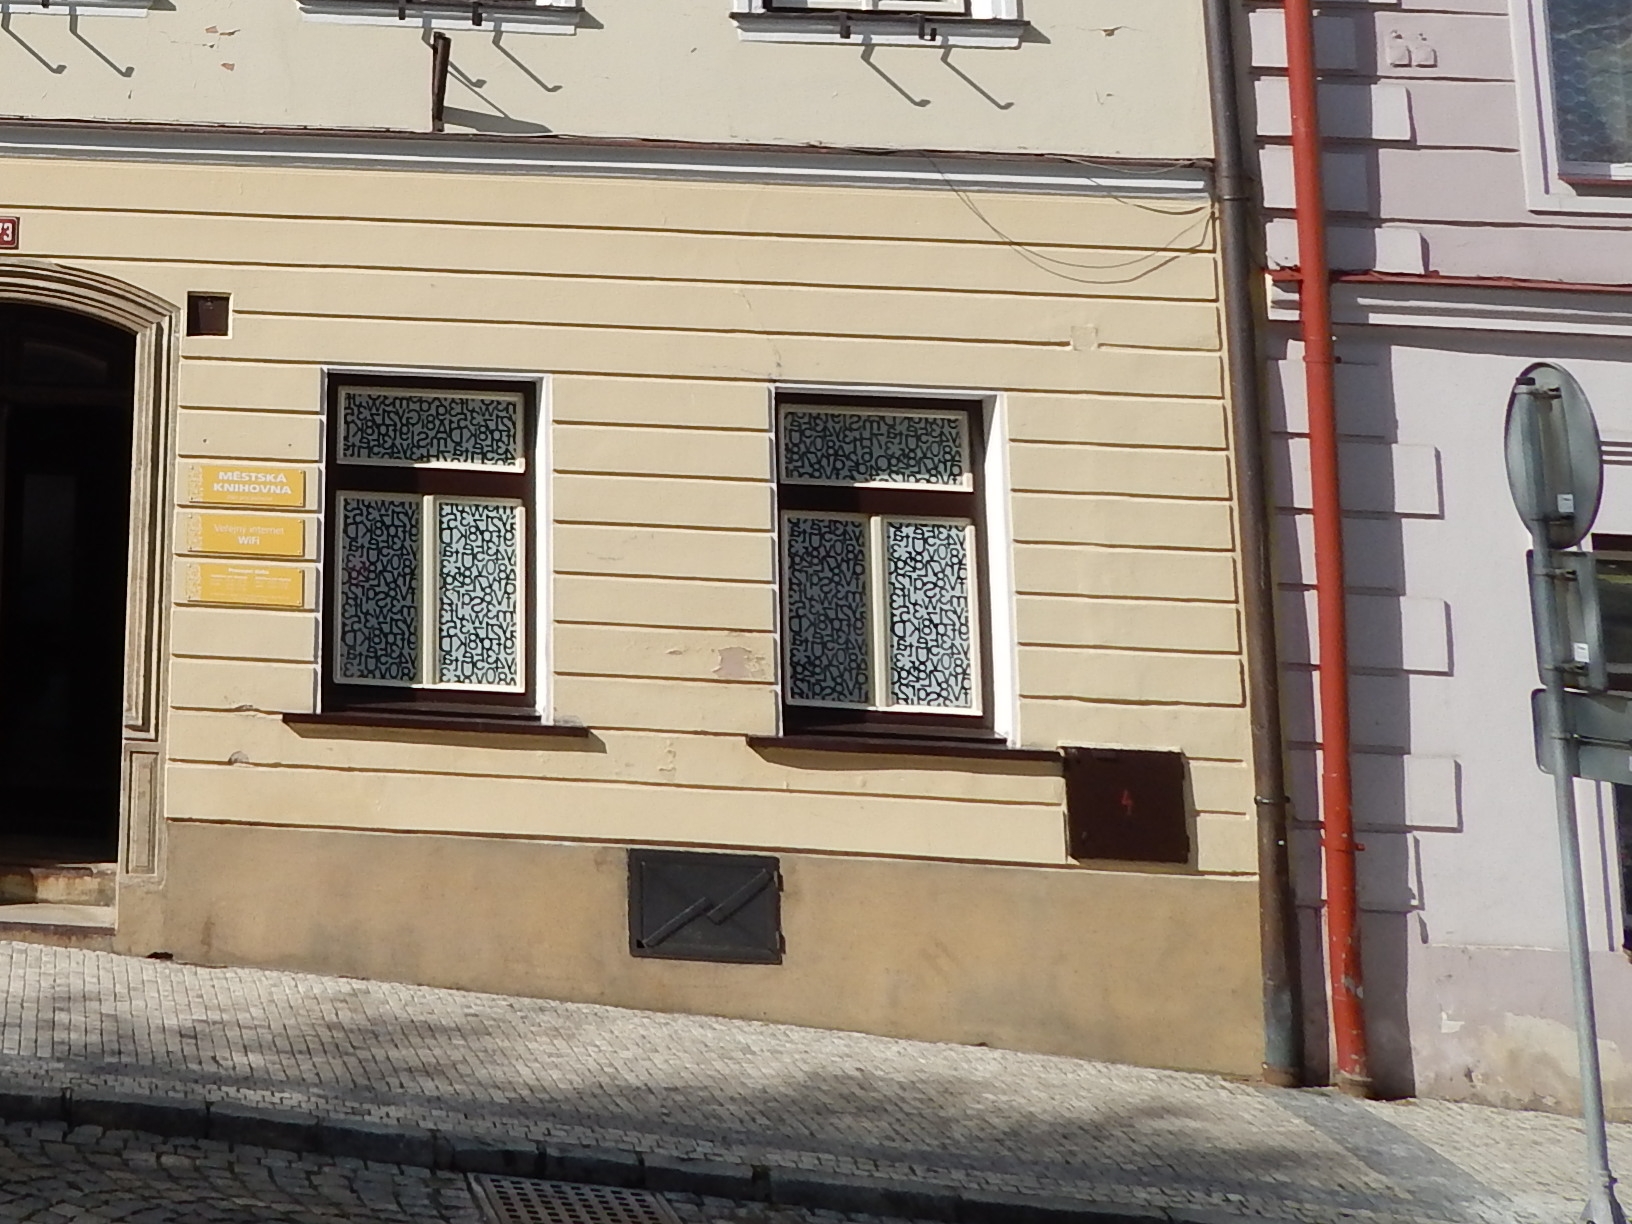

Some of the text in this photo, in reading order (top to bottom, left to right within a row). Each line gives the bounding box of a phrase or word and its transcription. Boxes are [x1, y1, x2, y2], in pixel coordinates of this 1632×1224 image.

[213, 482, 292, 494] KNIHOVNA
[249, 526, 284, 536] internet
[237, 535, 260, 545] WiFi
